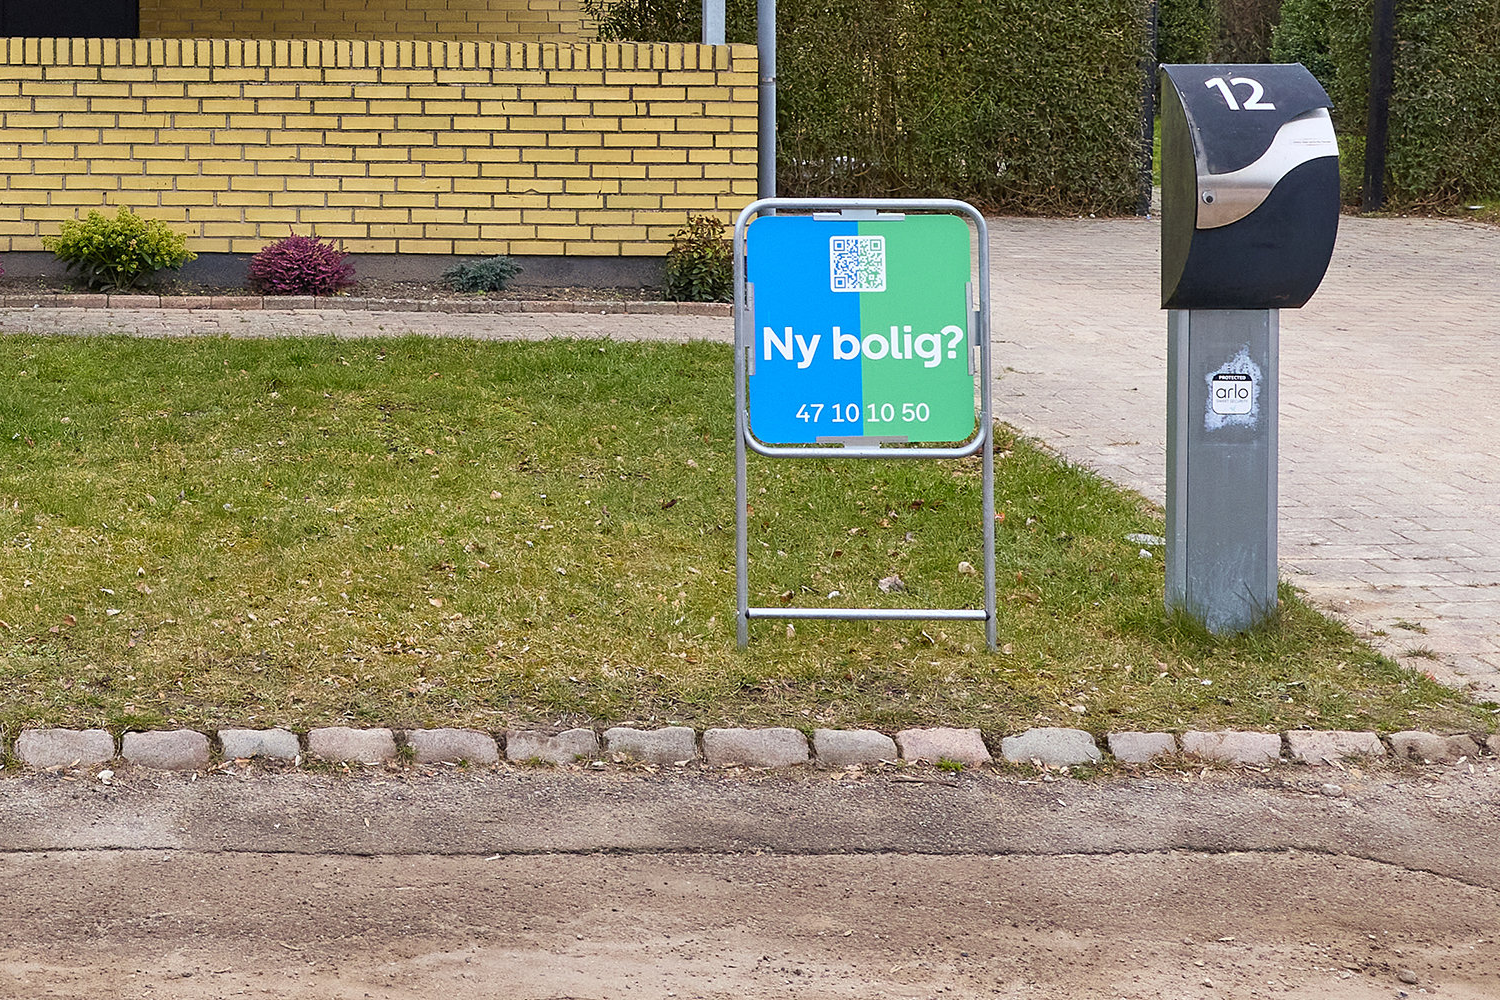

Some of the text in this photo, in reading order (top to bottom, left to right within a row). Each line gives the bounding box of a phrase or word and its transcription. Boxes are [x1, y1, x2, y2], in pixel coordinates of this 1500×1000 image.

[1204, 77, 1276, 111] 12
[763, 325, 964, 369] Ny bolig?
[1216, 384, 1249, 399] arlo
[796, 403, 930, 423] 47 10 10 50
